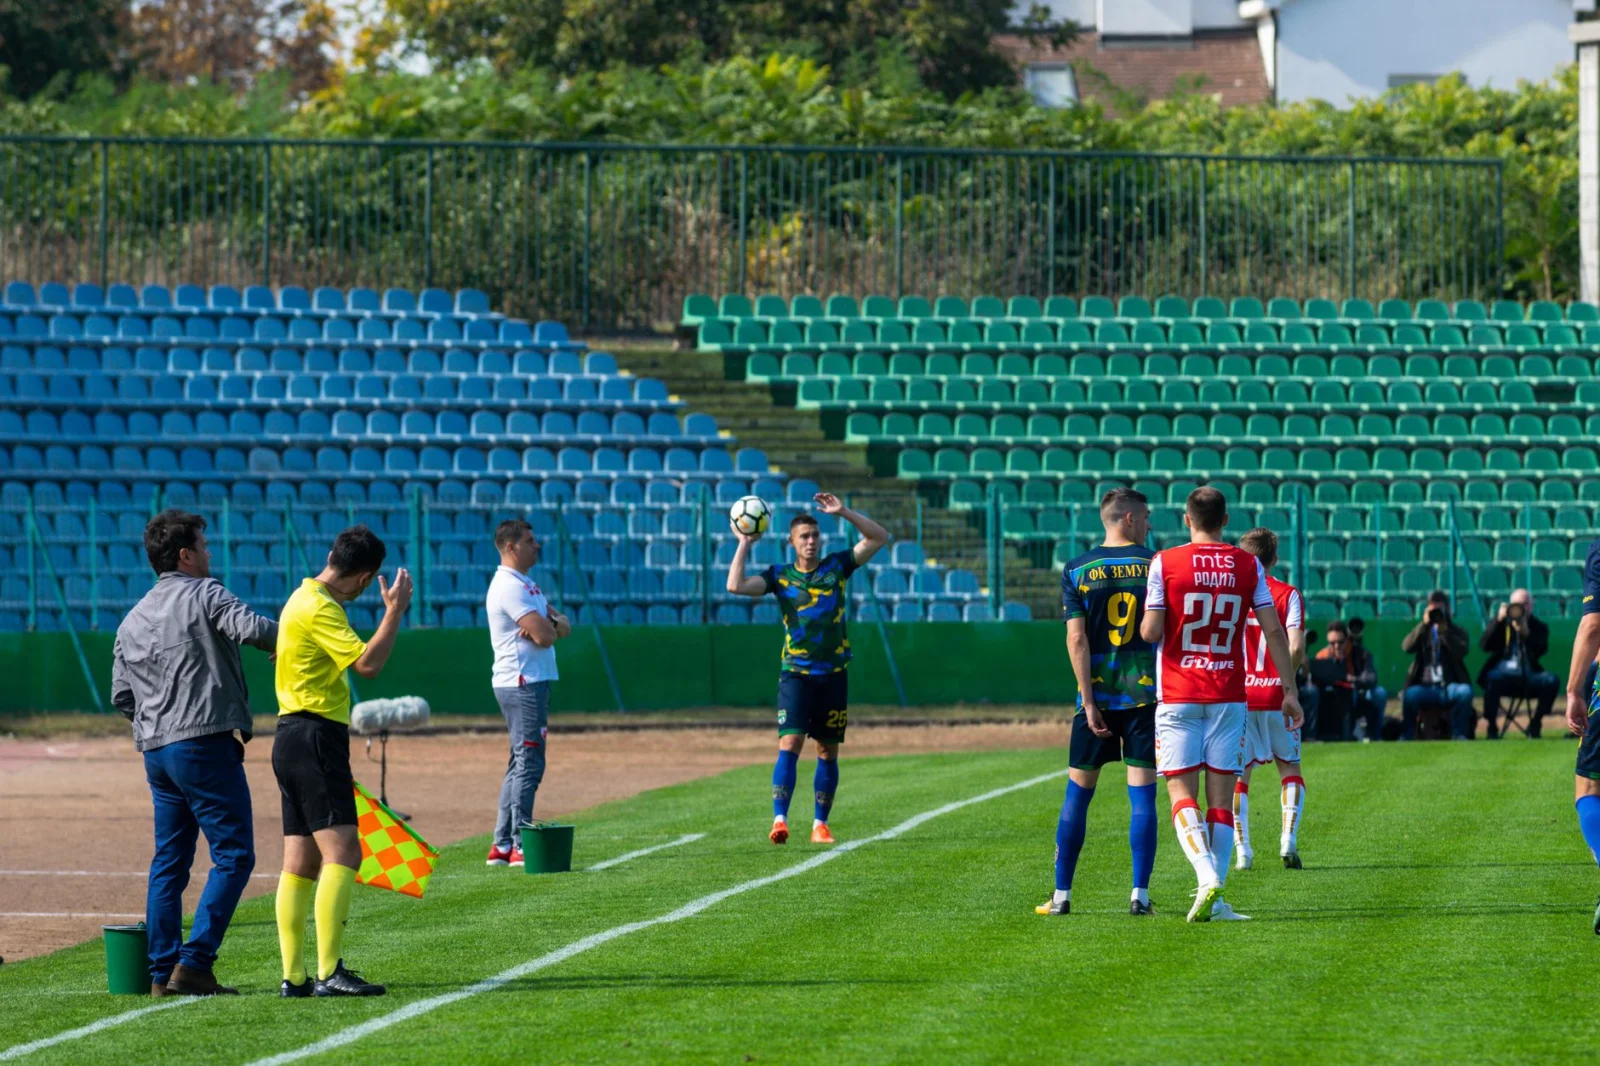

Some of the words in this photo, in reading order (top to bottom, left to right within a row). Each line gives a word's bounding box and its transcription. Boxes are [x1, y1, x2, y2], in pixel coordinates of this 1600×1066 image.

[1192, 552, 1235, 569] mts
[1088, 566, 1108, 581] ФК
[1193, 571, 1236, 588] РОДИЋ
[1107, 592, 1137, 647] 9
[1181, 592, 1243, 655] 23
